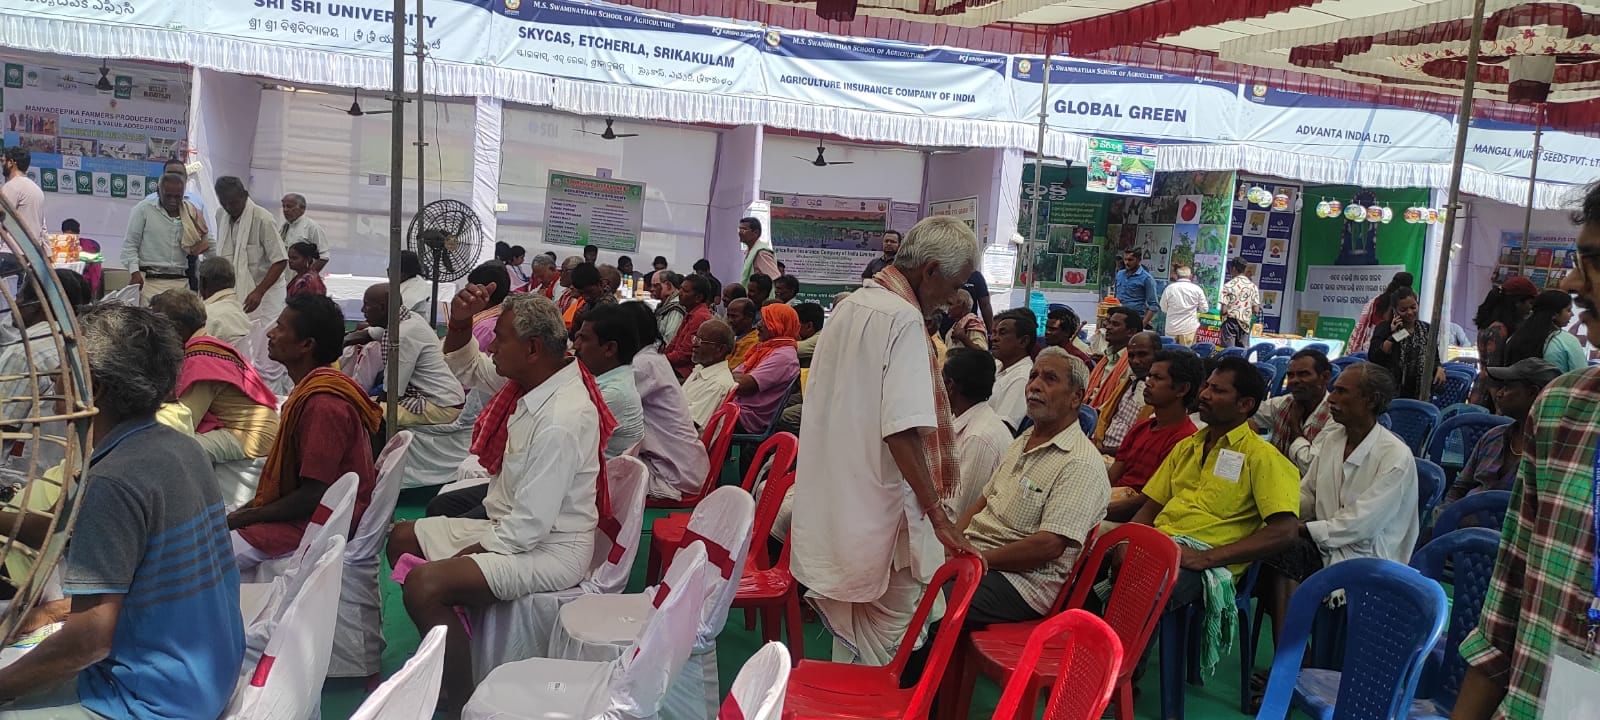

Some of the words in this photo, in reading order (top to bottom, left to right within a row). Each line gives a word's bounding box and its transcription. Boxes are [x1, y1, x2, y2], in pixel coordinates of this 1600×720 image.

[254, 0, 285, 9] SRI
[291, 0, 321, 15] SRI
[328, 3, 437, 29] UNIVERIY
[549, 4, 598, 17] SWAMINATHAN
[598, 10, 623, 22] SCHOOL
[518, 26, 575, 47] SKYCAS,
[579, 34, 650, 58] ETCHERLA,
[653, 46, 735, 68] SRIKAKULAM
[780, 73, 841, 89] AGRICULTURE
[843, 82, 893, 96] INSURANCE
[895, 87, 938, 100] COMPANY
[939, 92, 950, 101] OF
[952, 92, 976, 103] INDIA
[25, 105, 81, 117] MANYADEEPIKA
[81, 110, 114, 120] FARMERS
[115, 114, 153, 123] PRODUCER
[71, 117, 96, 125] MILLETS
[1053, 99, 1123, 118] GLOBAL
[1128, 105, 1187, 123] GREEN
[1296, 124, 1343, 139] ADVANTA
[1344, 130, 1370, 142] INDIA
[1373, 134, 1392, 145] LTD.
[1473, 143, 1512, 157] MANGAL
[1514, 149, 1542, 160] MURI
[1542, 152, 1568, 164] SEEDS
[1569, 155, 1588, 166] PVT.
